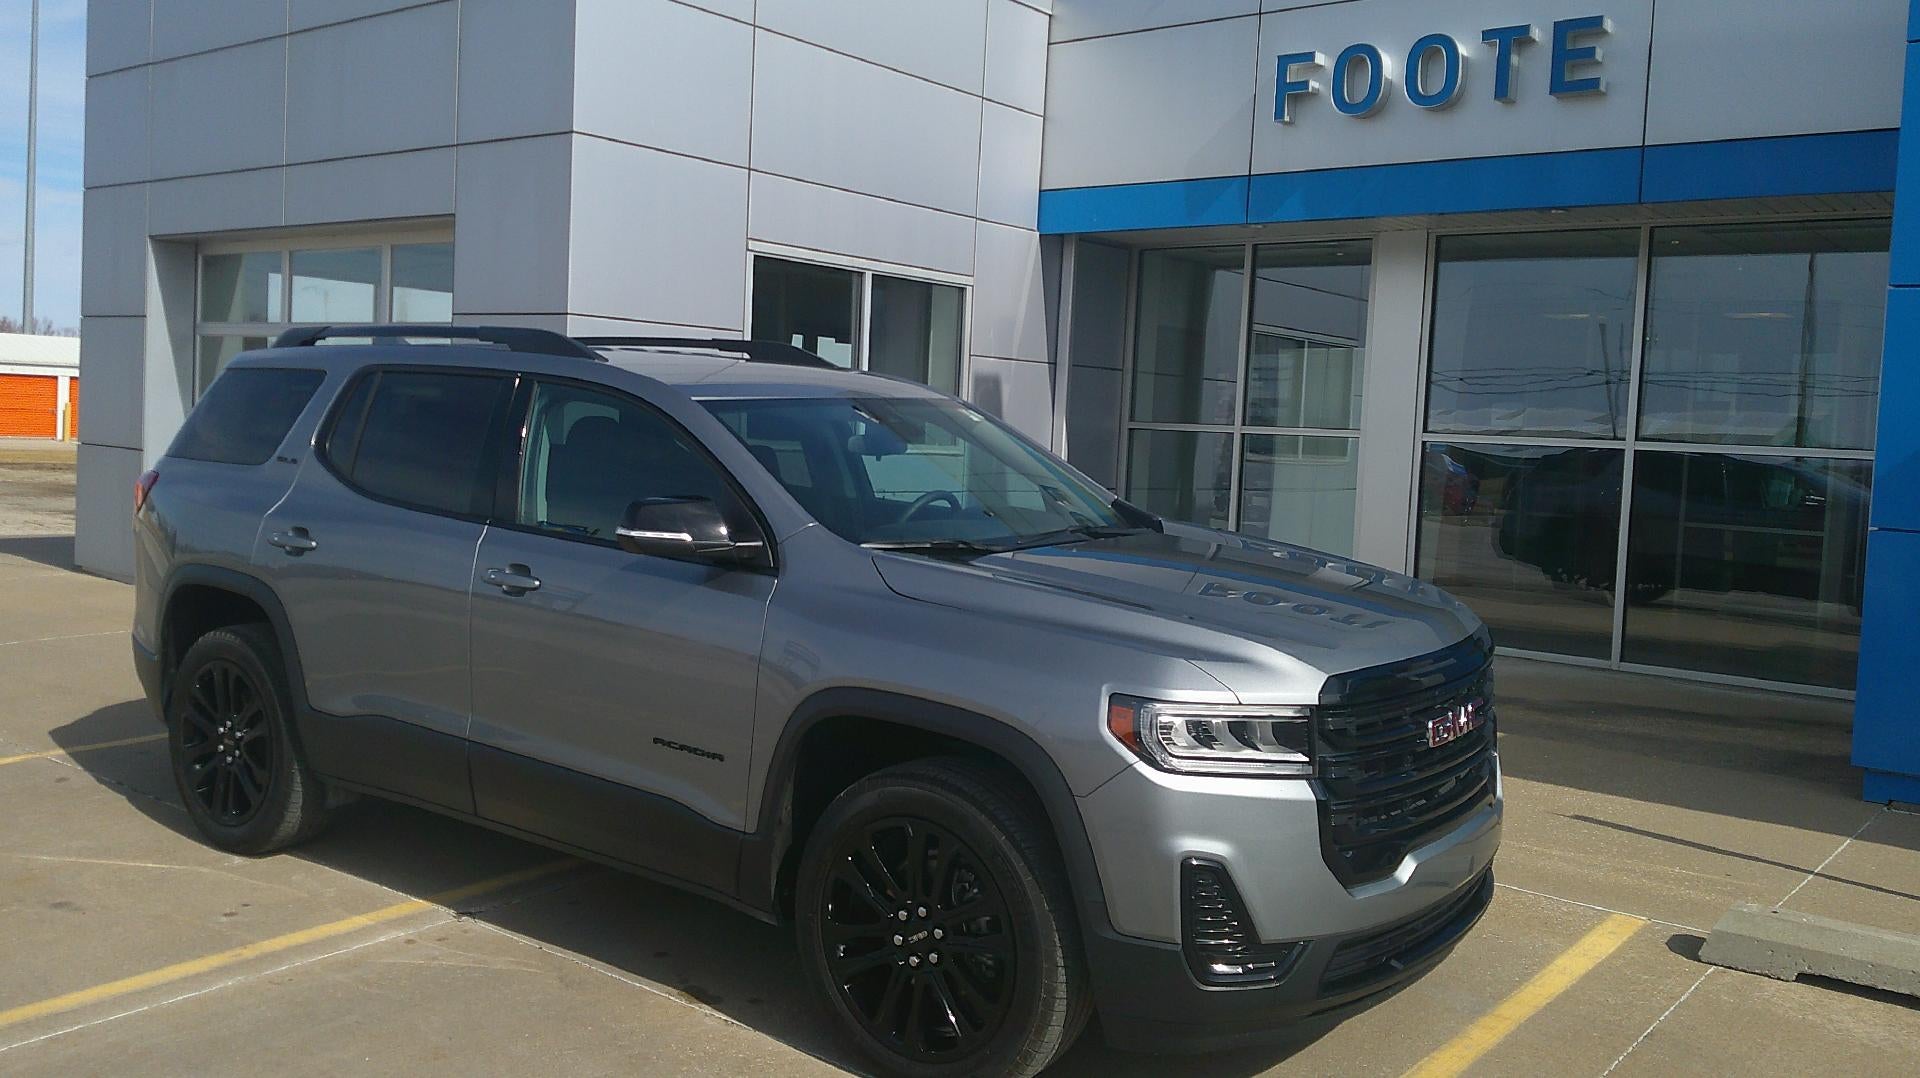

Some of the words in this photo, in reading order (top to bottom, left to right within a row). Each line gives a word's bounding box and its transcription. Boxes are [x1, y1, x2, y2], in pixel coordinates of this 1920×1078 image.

[1273, 15, 1613, 126] FOOTE
[1427, 697, 1484, 748] GMC
[652, 737, 725, 762] ACADIA
